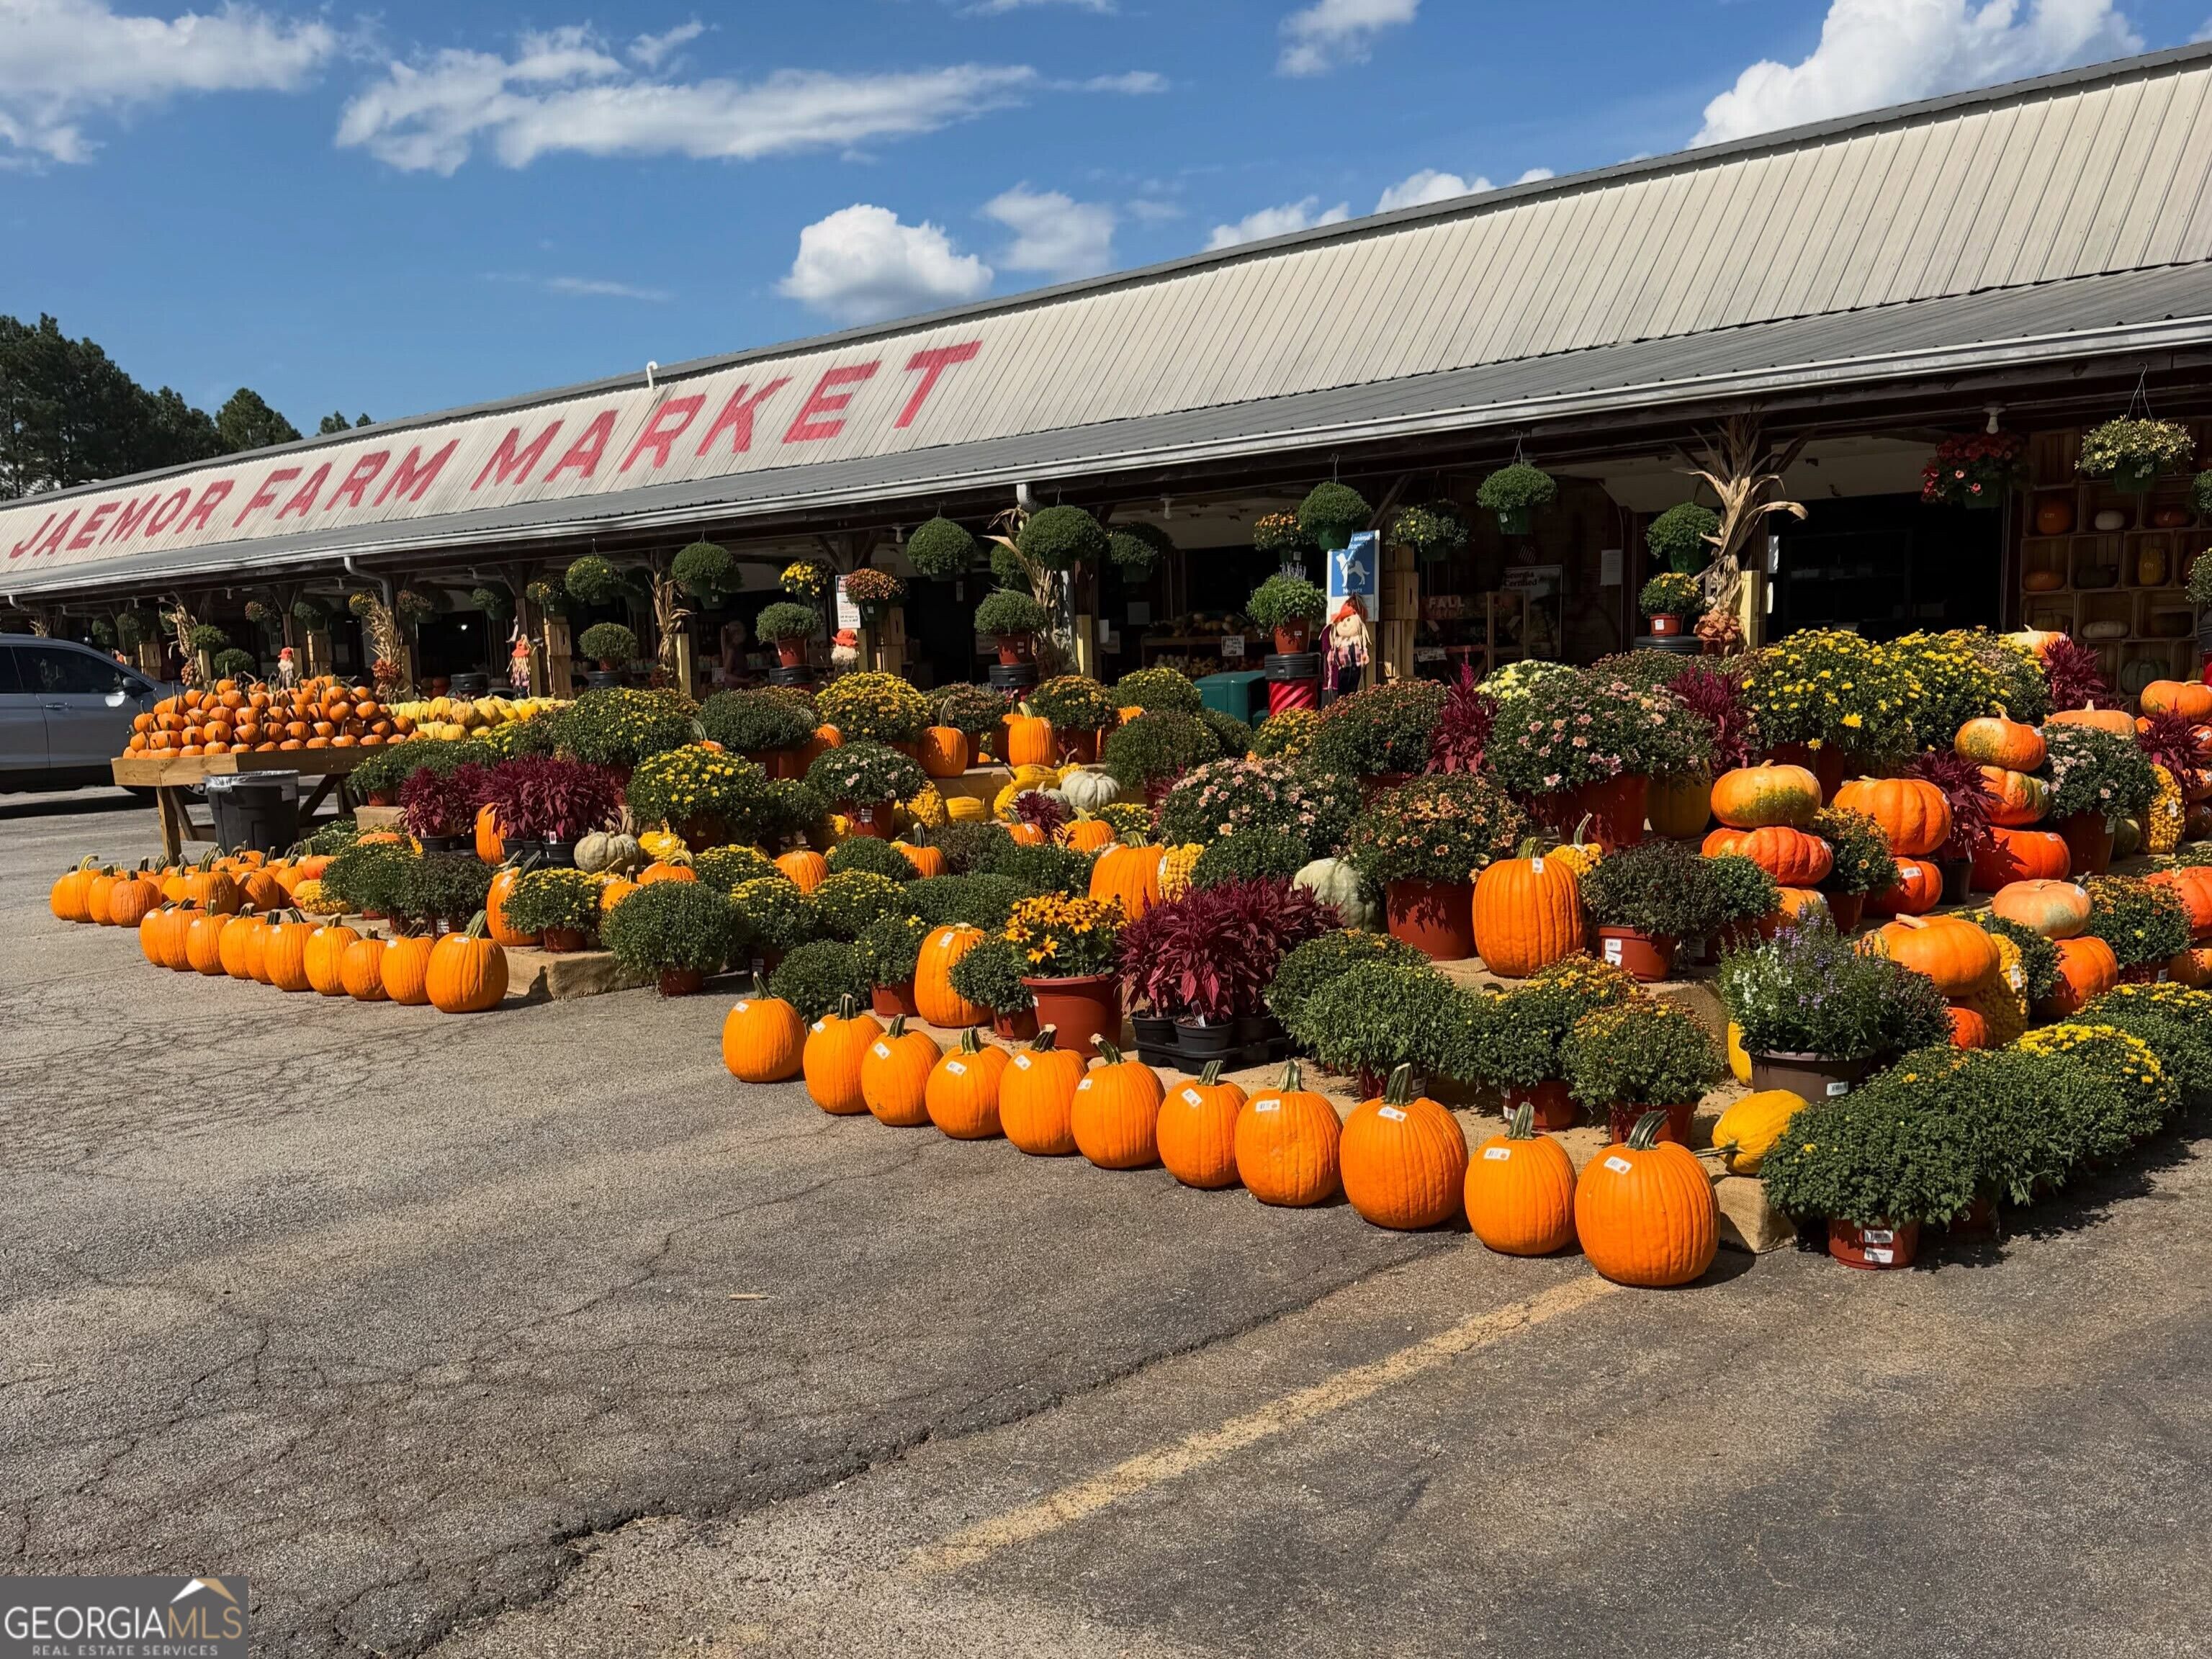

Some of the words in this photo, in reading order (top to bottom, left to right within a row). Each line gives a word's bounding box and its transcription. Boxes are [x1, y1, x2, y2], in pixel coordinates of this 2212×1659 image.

[9, 479, 235, 559] JAEMOR
[232, 438, 461, 528] FARM
[470, 339, 983, 492] MARKET
[1429, 595, 1465, 608] FALL
